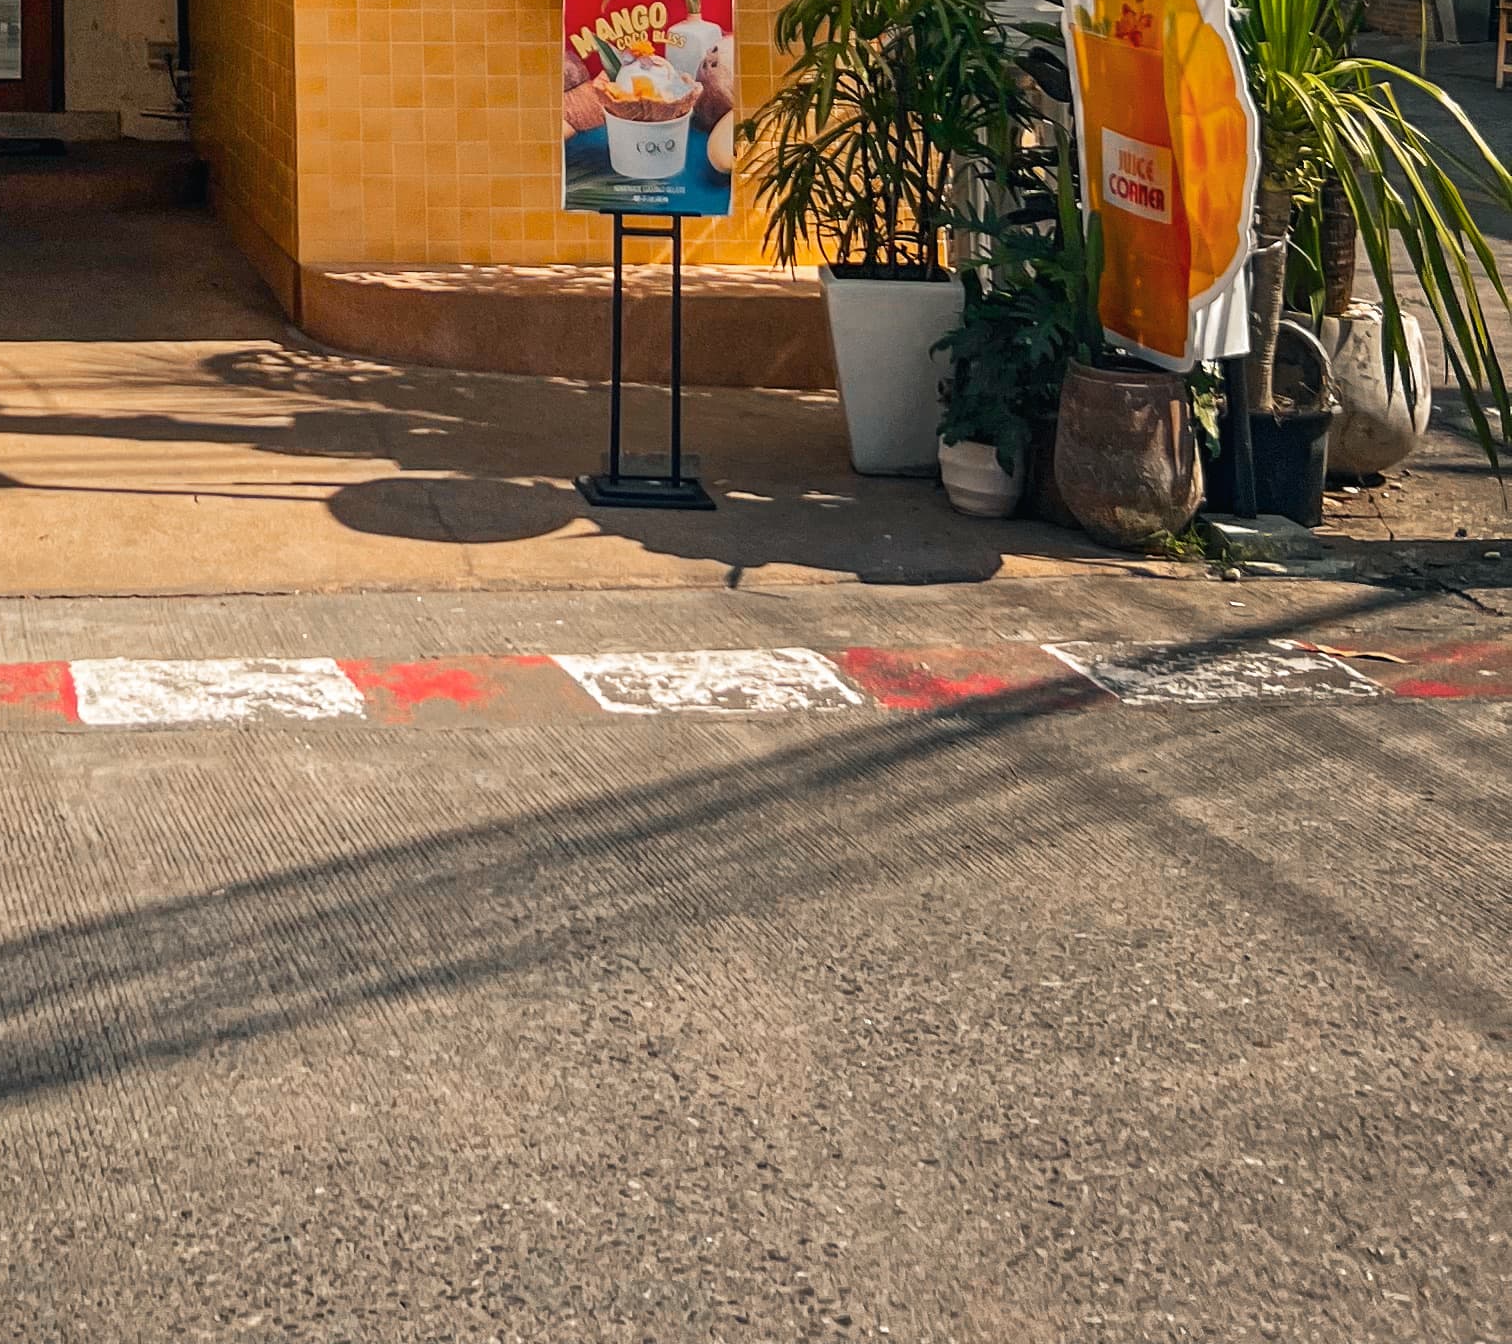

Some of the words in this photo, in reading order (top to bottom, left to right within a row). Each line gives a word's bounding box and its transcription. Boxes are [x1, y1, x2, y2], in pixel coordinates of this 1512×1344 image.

[569, 1, 667, 59] MANGO
[1118, 149, 1154, 182] JUICE
[1109, 173, 1165, 211] CORNER
